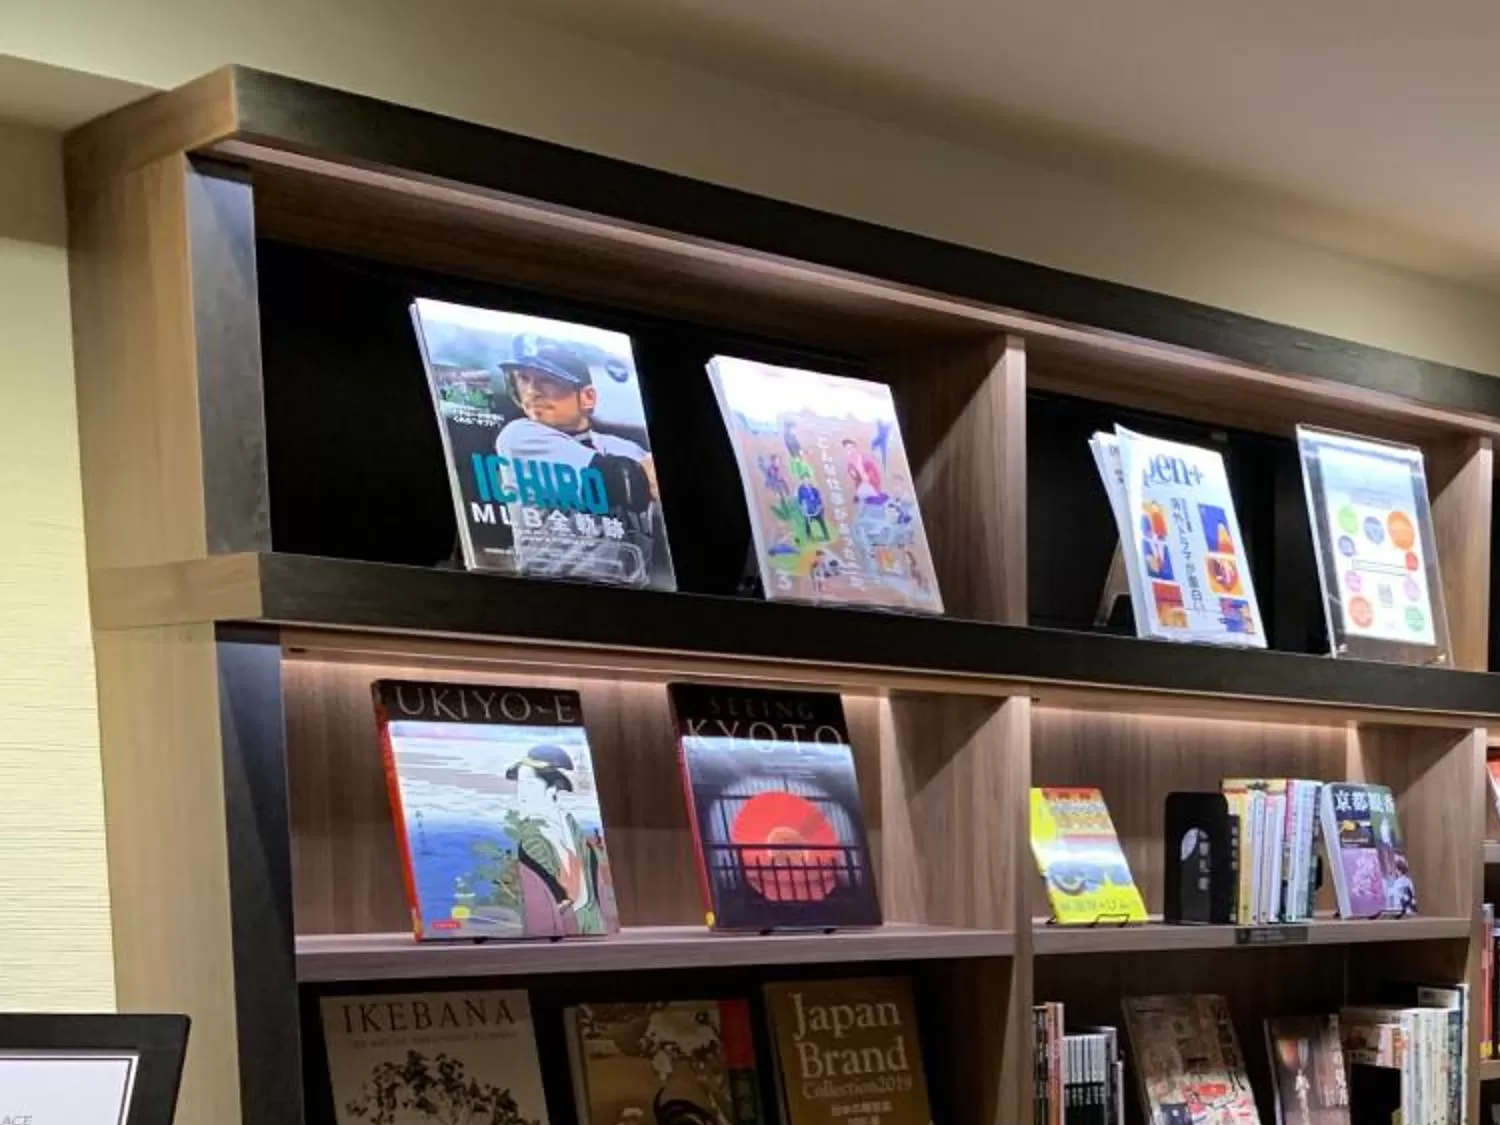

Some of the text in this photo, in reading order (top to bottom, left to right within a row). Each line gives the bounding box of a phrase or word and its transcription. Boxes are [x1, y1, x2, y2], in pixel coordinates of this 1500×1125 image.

[471, 452, 610, 515] ICHIRO
[396, 686, 576, 723] UKIYO-E
[687, 719, 844, 755] KYOTO
[342, 998, 517, 1034] IKEBANA
[790, 992, 902, 1040] Japan
[793, 1036, 910, 1080] Brand
[0, 1115, 32, 1125] ACE
